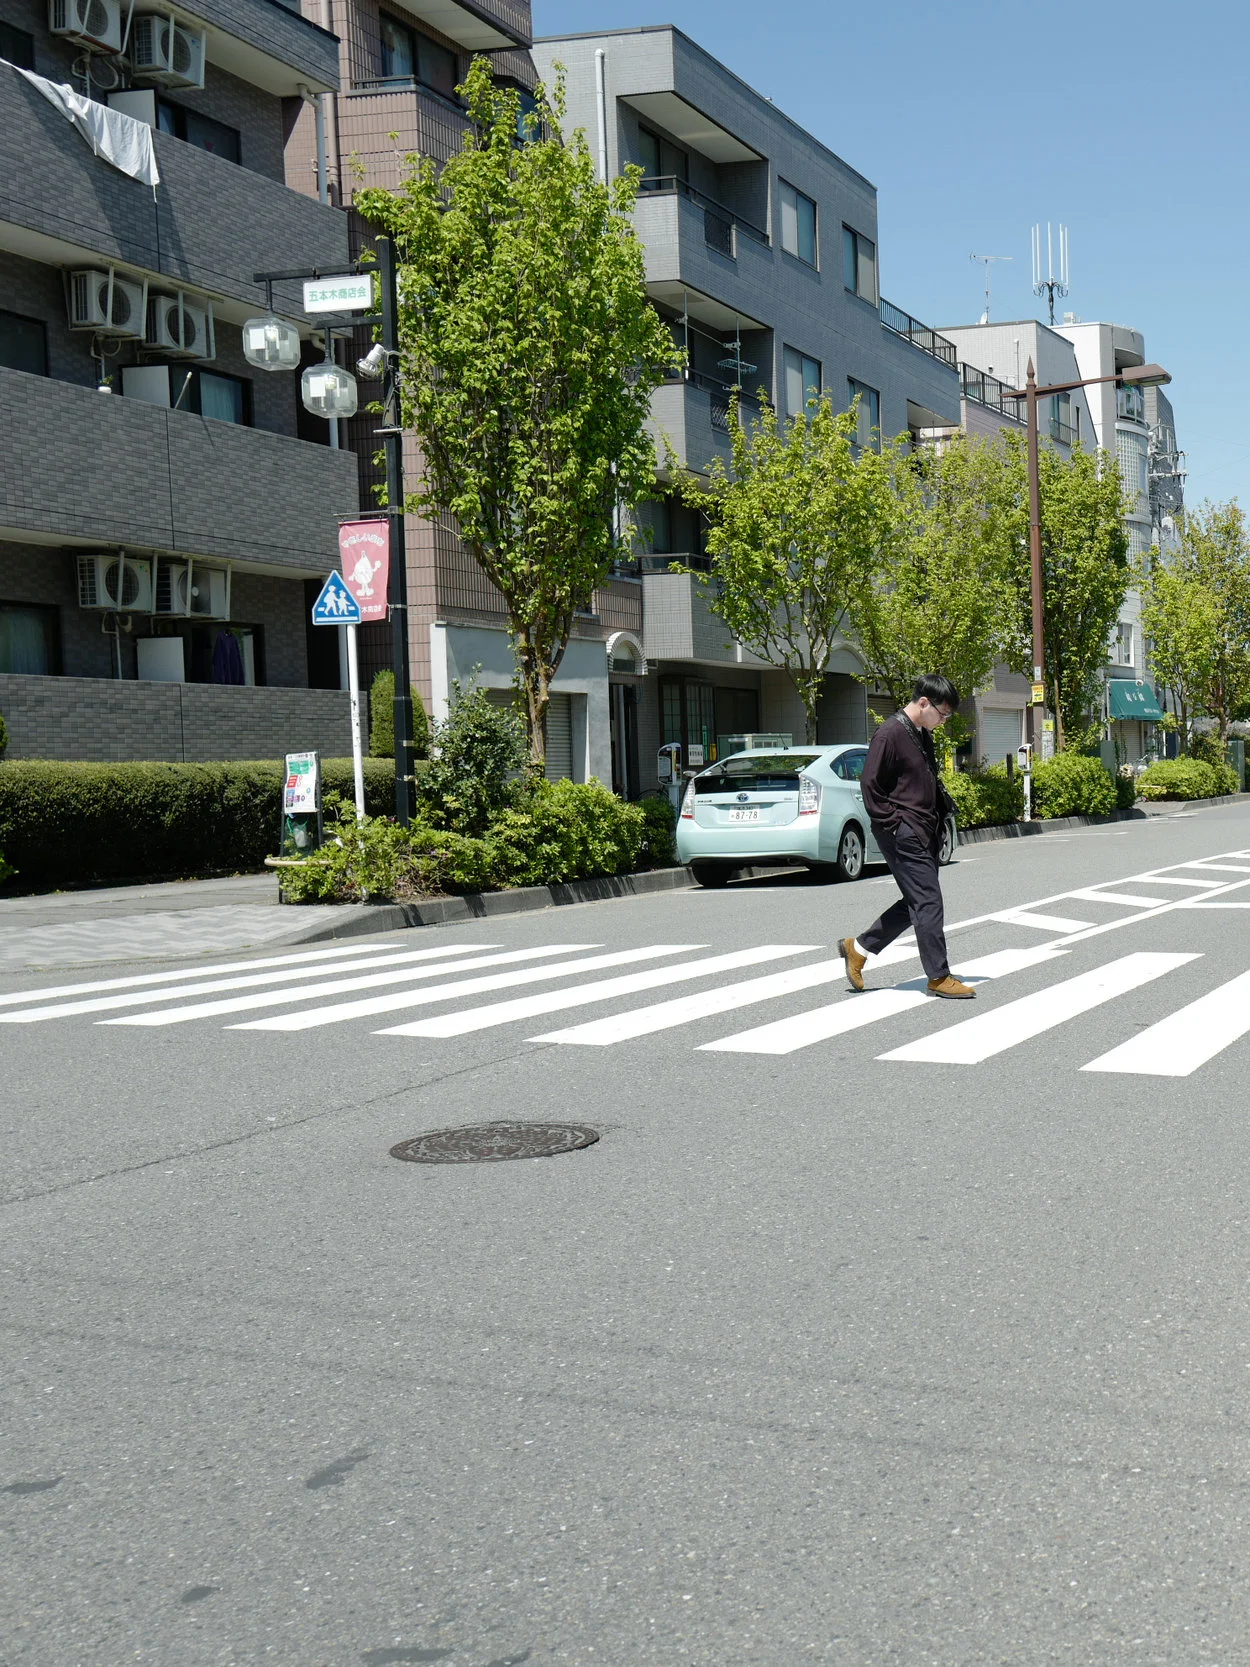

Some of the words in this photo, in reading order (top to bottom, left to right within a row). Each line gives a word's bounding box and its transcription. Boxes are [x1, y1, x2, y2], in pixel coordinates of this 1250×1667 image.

[308, 286, 367, 302] 五本木商店会
